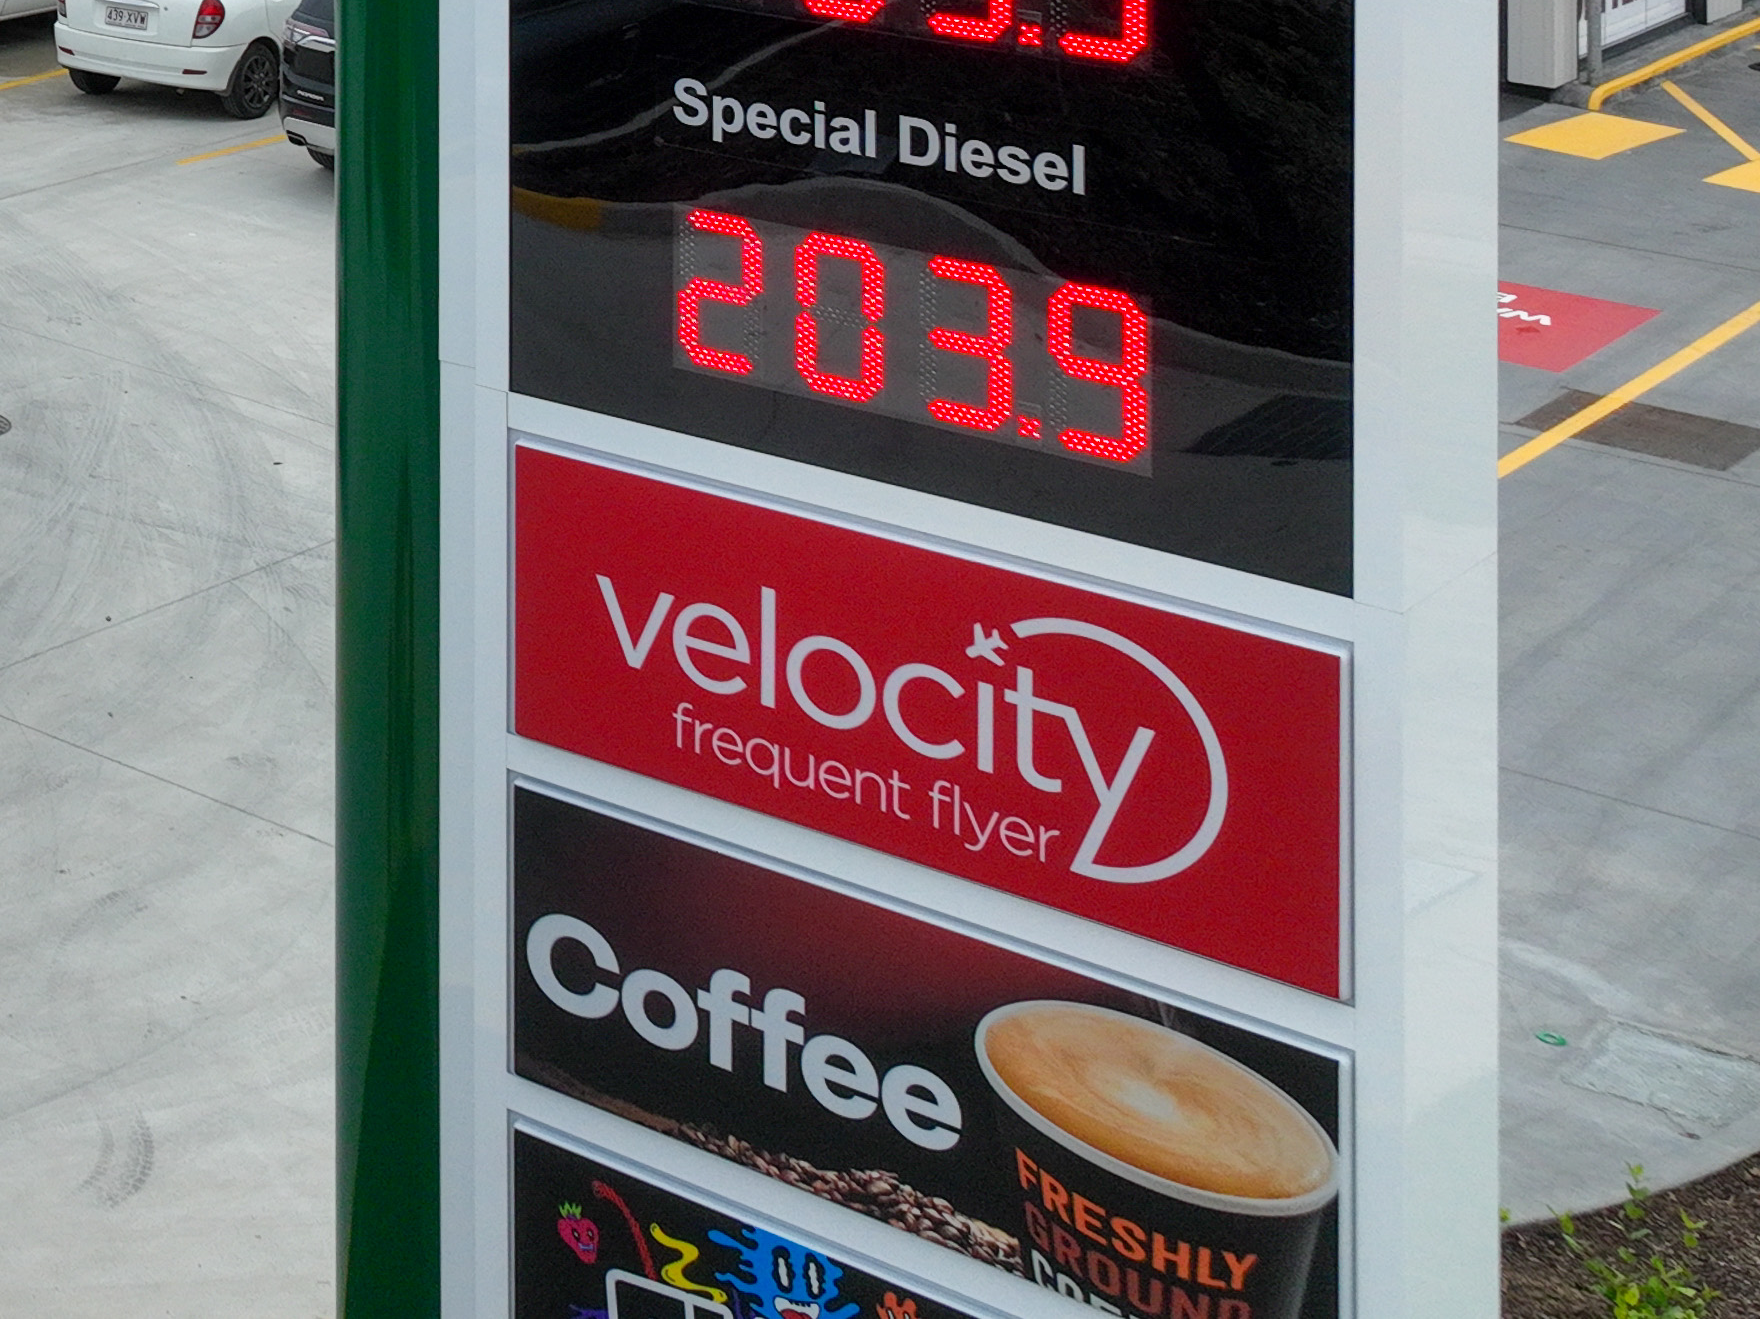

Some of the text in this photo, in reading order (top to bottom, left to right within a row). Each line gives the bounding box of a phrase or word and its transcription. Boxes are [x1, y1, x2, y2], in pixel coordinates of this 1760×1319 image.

[672, 78, 1086, 195] Special Diesel
[678, 208, 1147, 462] 203.9
[595, 573, 1229, 884] velocity
[672, 702, 1060, 863] frequent flyer
[525, 912, 964, 1151] Coffee
[1015, 1147, 1258, 1291] FRESHLY
